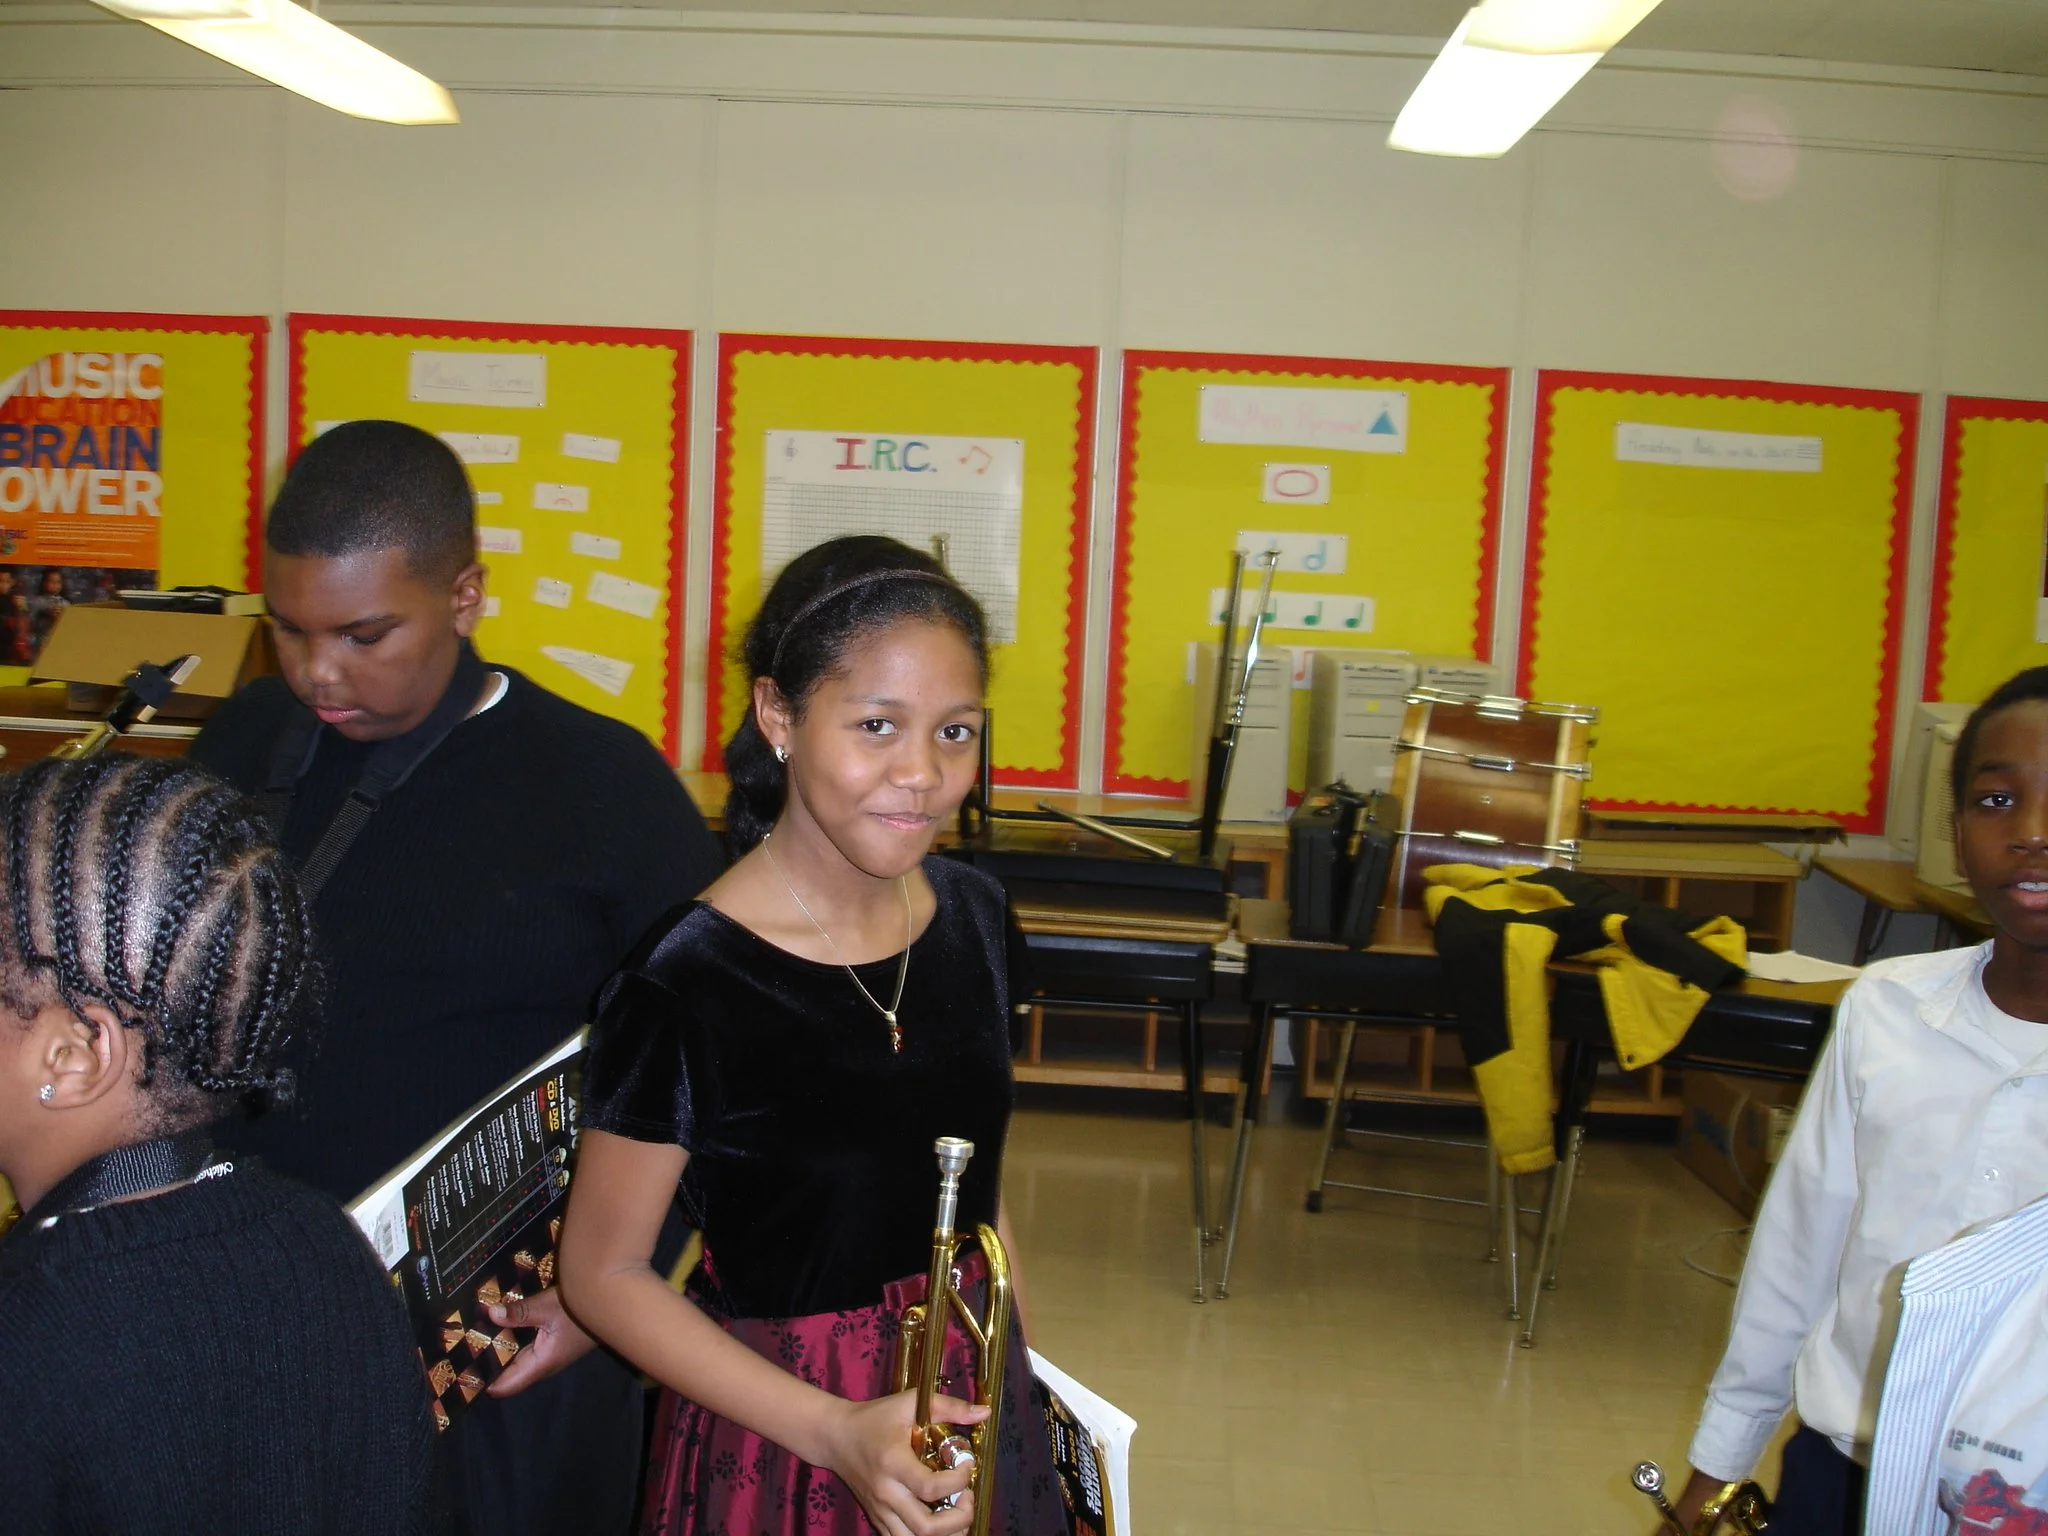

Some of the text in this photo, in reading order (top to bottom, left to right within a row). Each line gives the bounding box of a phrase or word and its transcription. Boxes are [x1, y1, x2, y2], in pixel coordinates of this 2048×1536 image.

[0, 423, 161, 472] BRAIN
[546, 1080, 556, 1100] CD
[551, 1107, 560, 1130] DVD
[1068, 1428, 1077, 1464] BOOK
